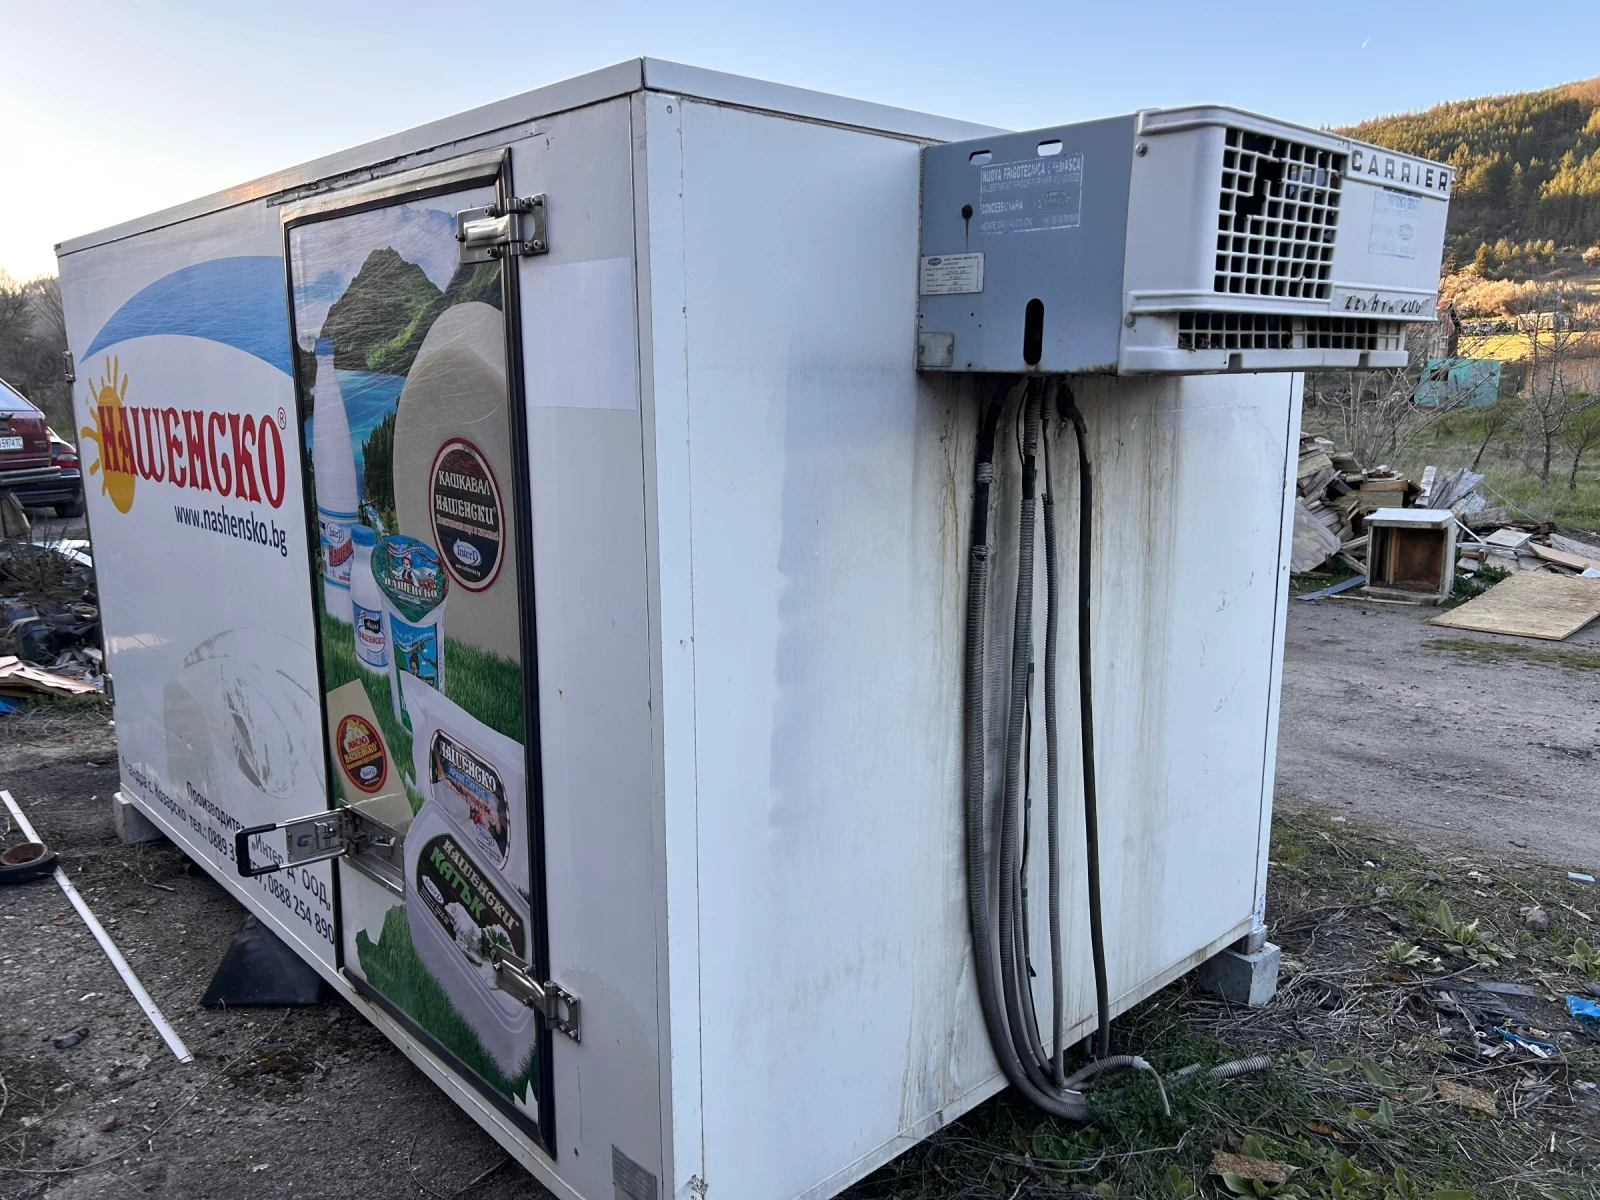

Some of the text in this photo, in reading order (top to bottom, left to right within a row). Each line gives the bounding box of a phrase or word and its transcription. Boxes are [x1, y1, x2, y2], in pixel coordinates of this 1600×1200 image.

[982, 168, 1002, 183] NUOVA
[1351, 148, 1449, 191] CARRIER
[437, 470, 491, 497] КАШКАВАЛ
[174, 504, 288, 558] www.nashensko.bg
[456, 544, 479, 563] InterD
[439, 739, 497, 794] НАШЕНСКО
[154, 781, 186, 822] Козарско
[207, 826, 228, 857] 0889
[267, 873, 292, 910] 0888
[292, 894, 313, 927] 254
[314, 911, 335, 947] 890
[429, 846, 486, 922] КАТЪК
[301, 867, 332, 912] ООД,
